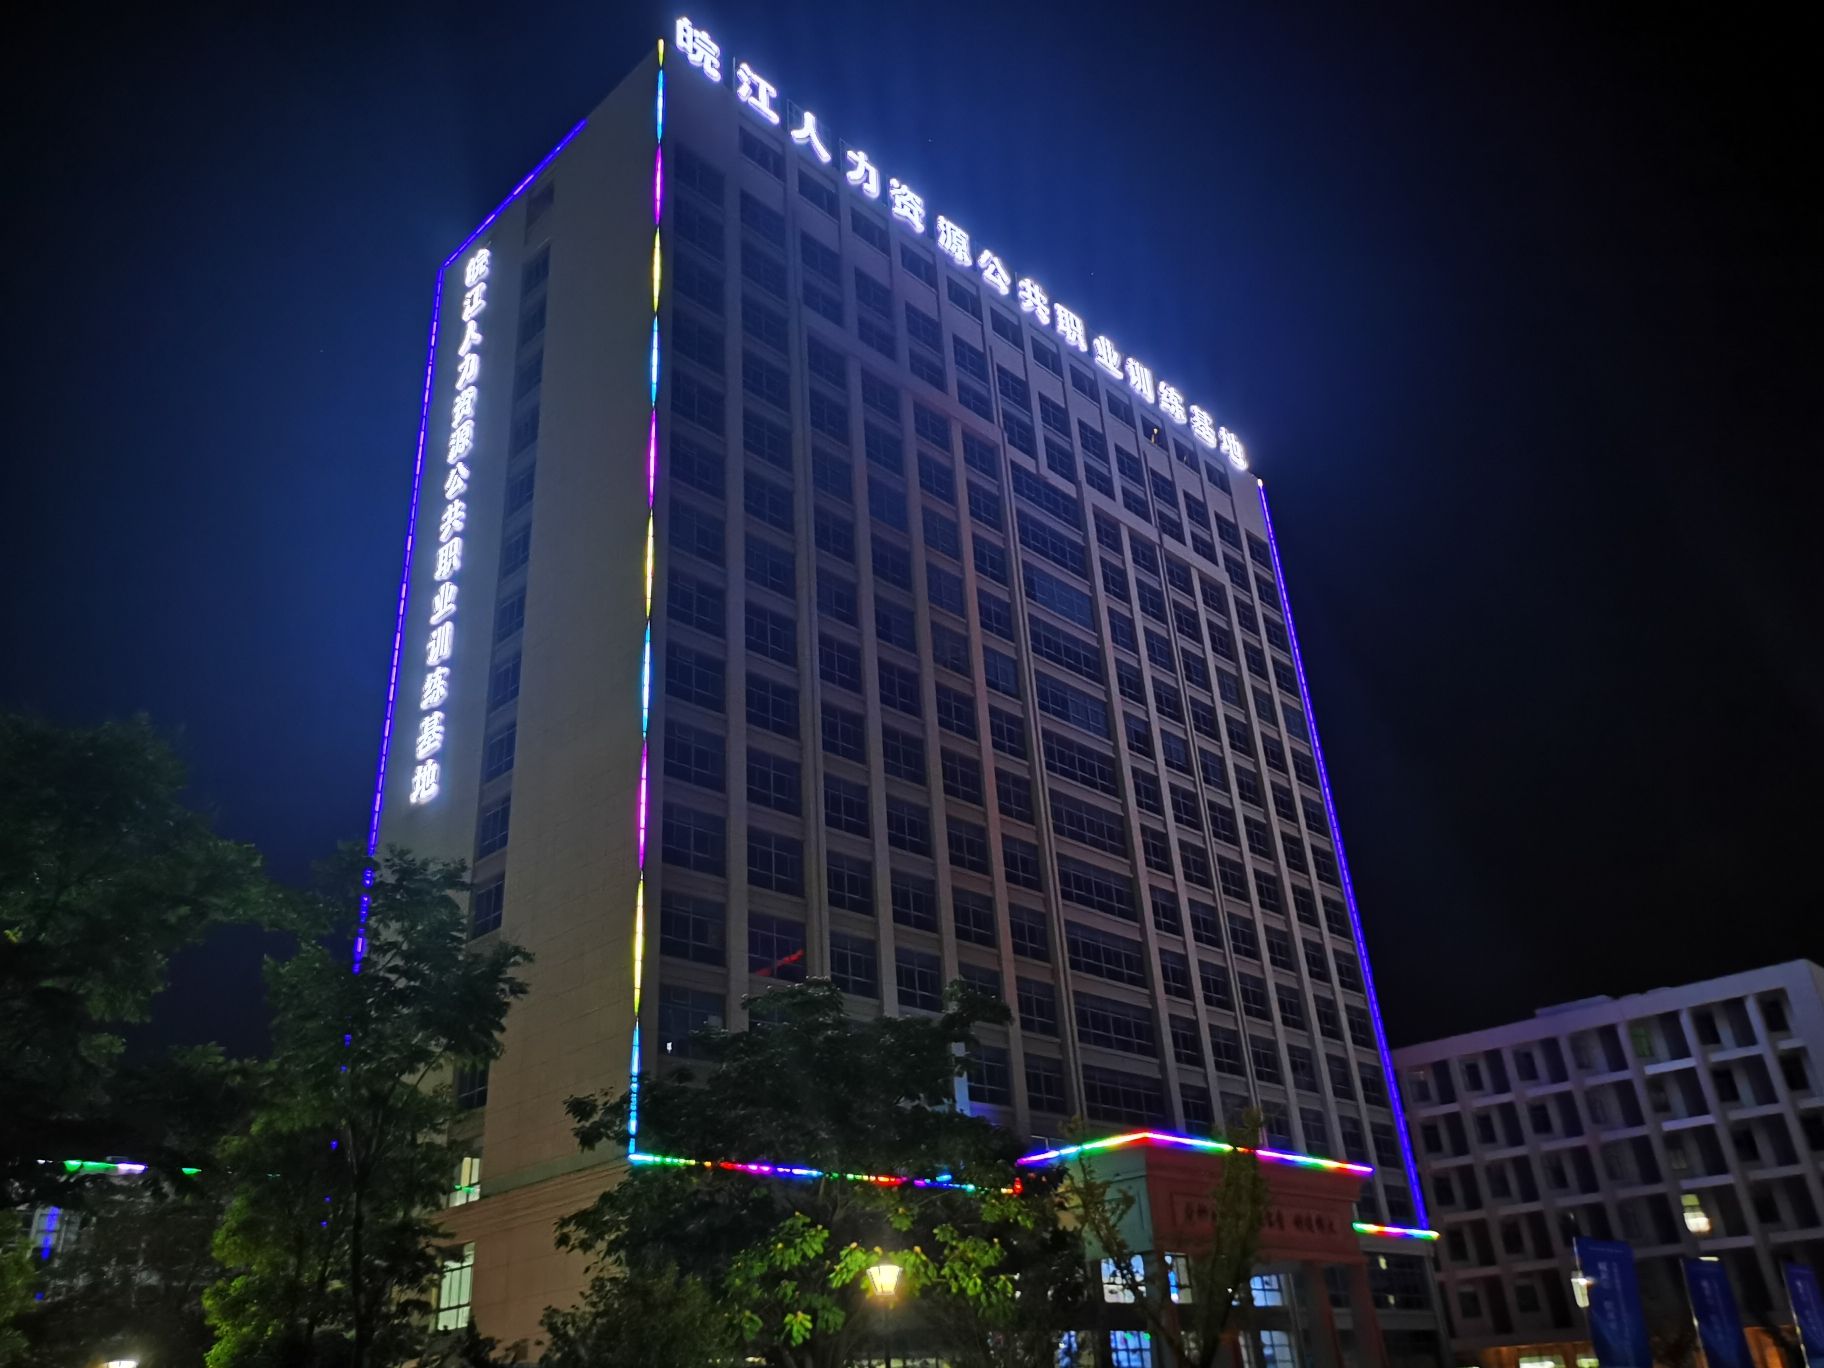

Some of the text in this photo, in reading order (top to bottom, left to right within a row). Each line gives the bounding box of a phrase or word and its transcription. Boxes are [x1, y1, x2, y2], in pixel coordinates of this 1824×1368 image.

[675, 17, 1248, 471] 皖江人力资源公共职业训练基地
[409, 248, 491, 805] 皖江人力资源公共职业训练基地
